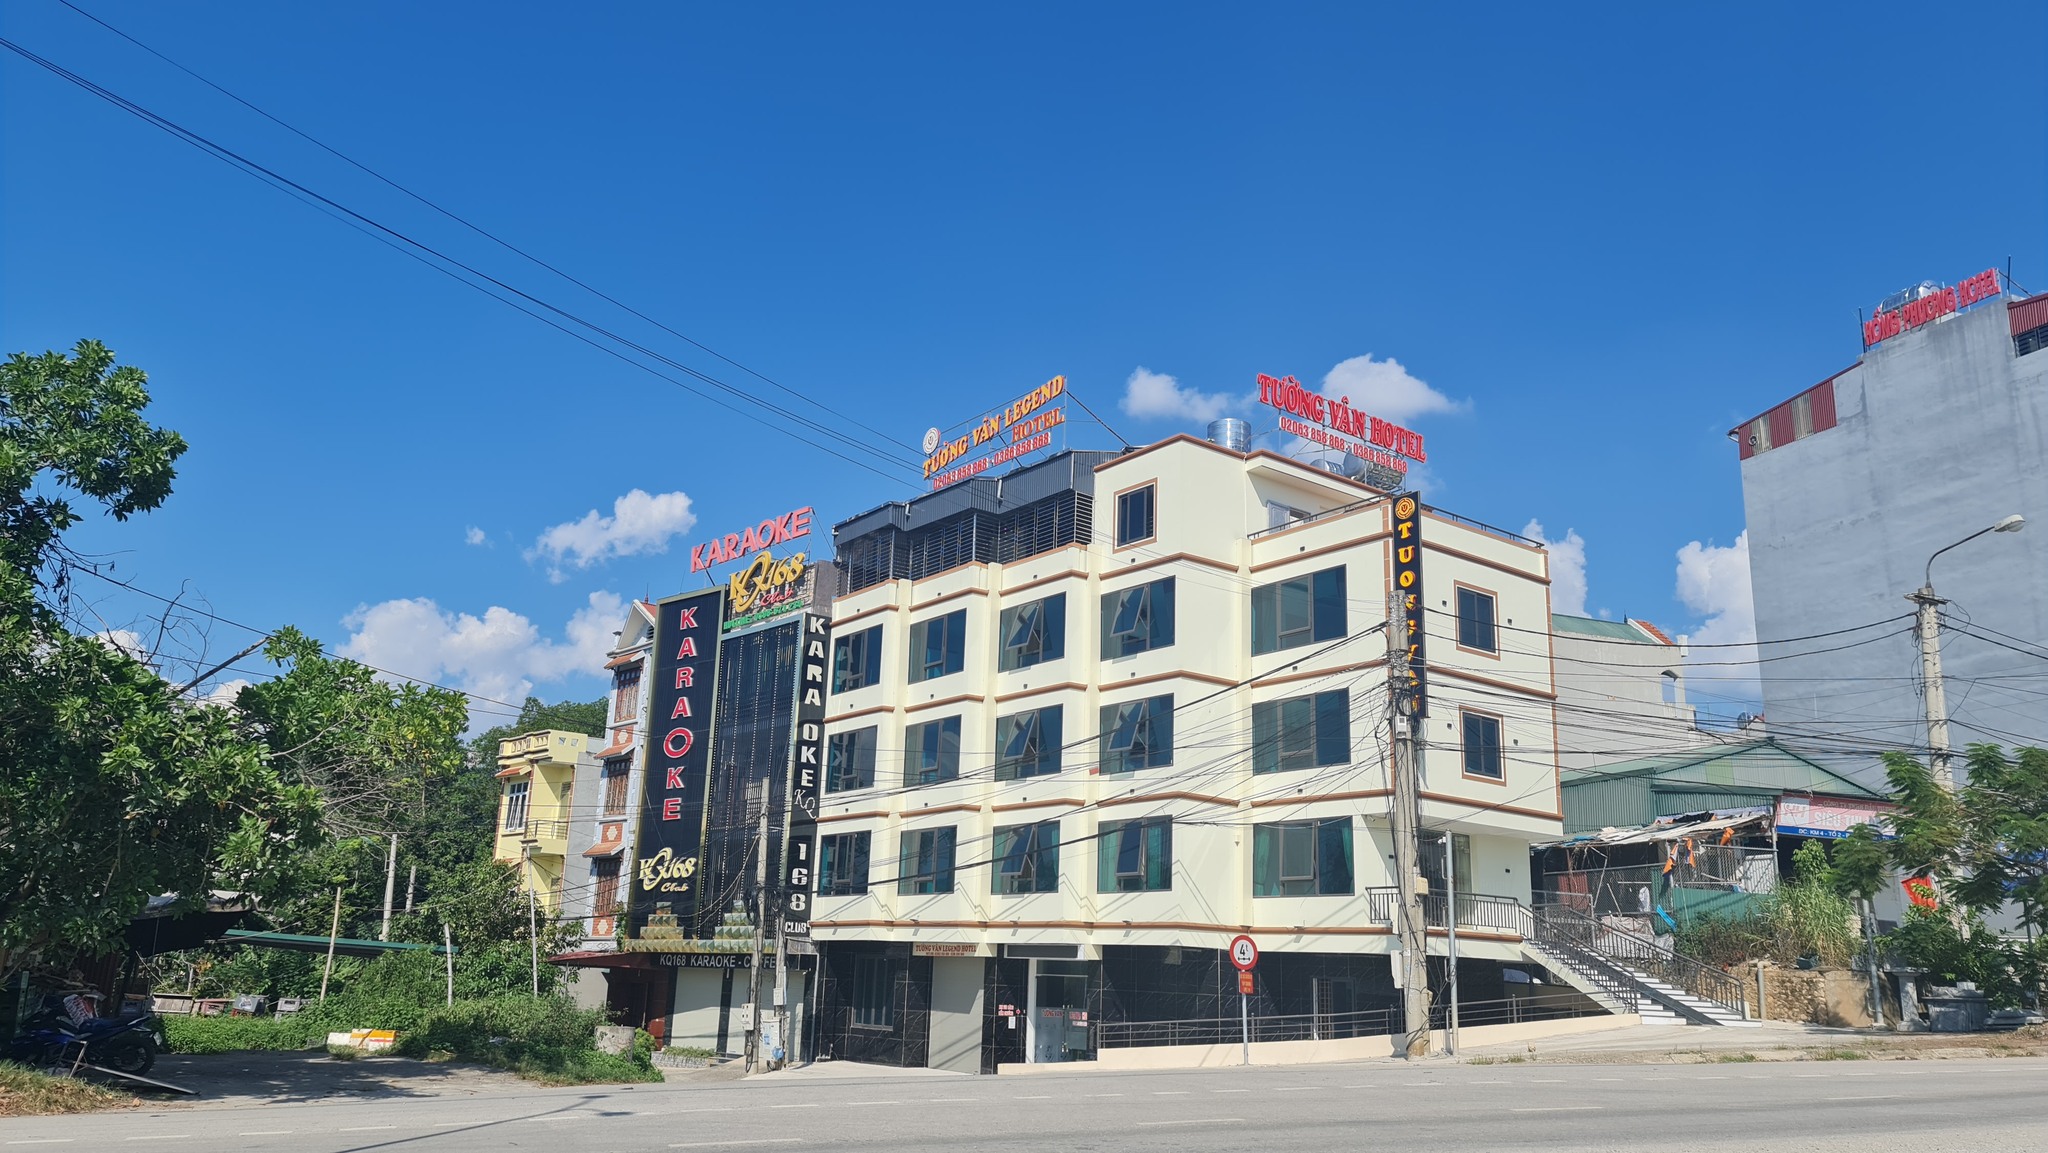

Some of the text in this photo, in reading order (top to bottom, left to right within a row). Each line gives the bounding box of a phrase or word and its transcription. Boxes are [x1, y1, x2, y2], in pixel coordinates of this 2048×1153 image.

[1958, 268, 2000, 307] HOTEL
[923, 374, 1065, 479] TƯỜNG VÂN LEGEND
[1011, 406, 1065, 444] HOTEL
[1257, 372, 1427, 463] TƯỜNG VÂN HOTEL
[1279, 416, 1309, 438] 02063
[1310, 427, 1328, 445] 858
[1328, 433, 1346, 451] 868
[1375, 450, 1391, 468] 858
[1392, 457, 1408, 474] 868
[690, 506, 811, 573] KARAOKE
[663, 606, 698, 820] KARAOKE
[1815, 810, 1841, 827] SIÊU
[785, 921, 807, 934] CLUB
[660, 954, 687, 966] KQ168
[690, 955, 736, 968] KARAOKE
[943, 944, 961, 952] LEGEND
[962, 944, 977, 952] HOTEL
